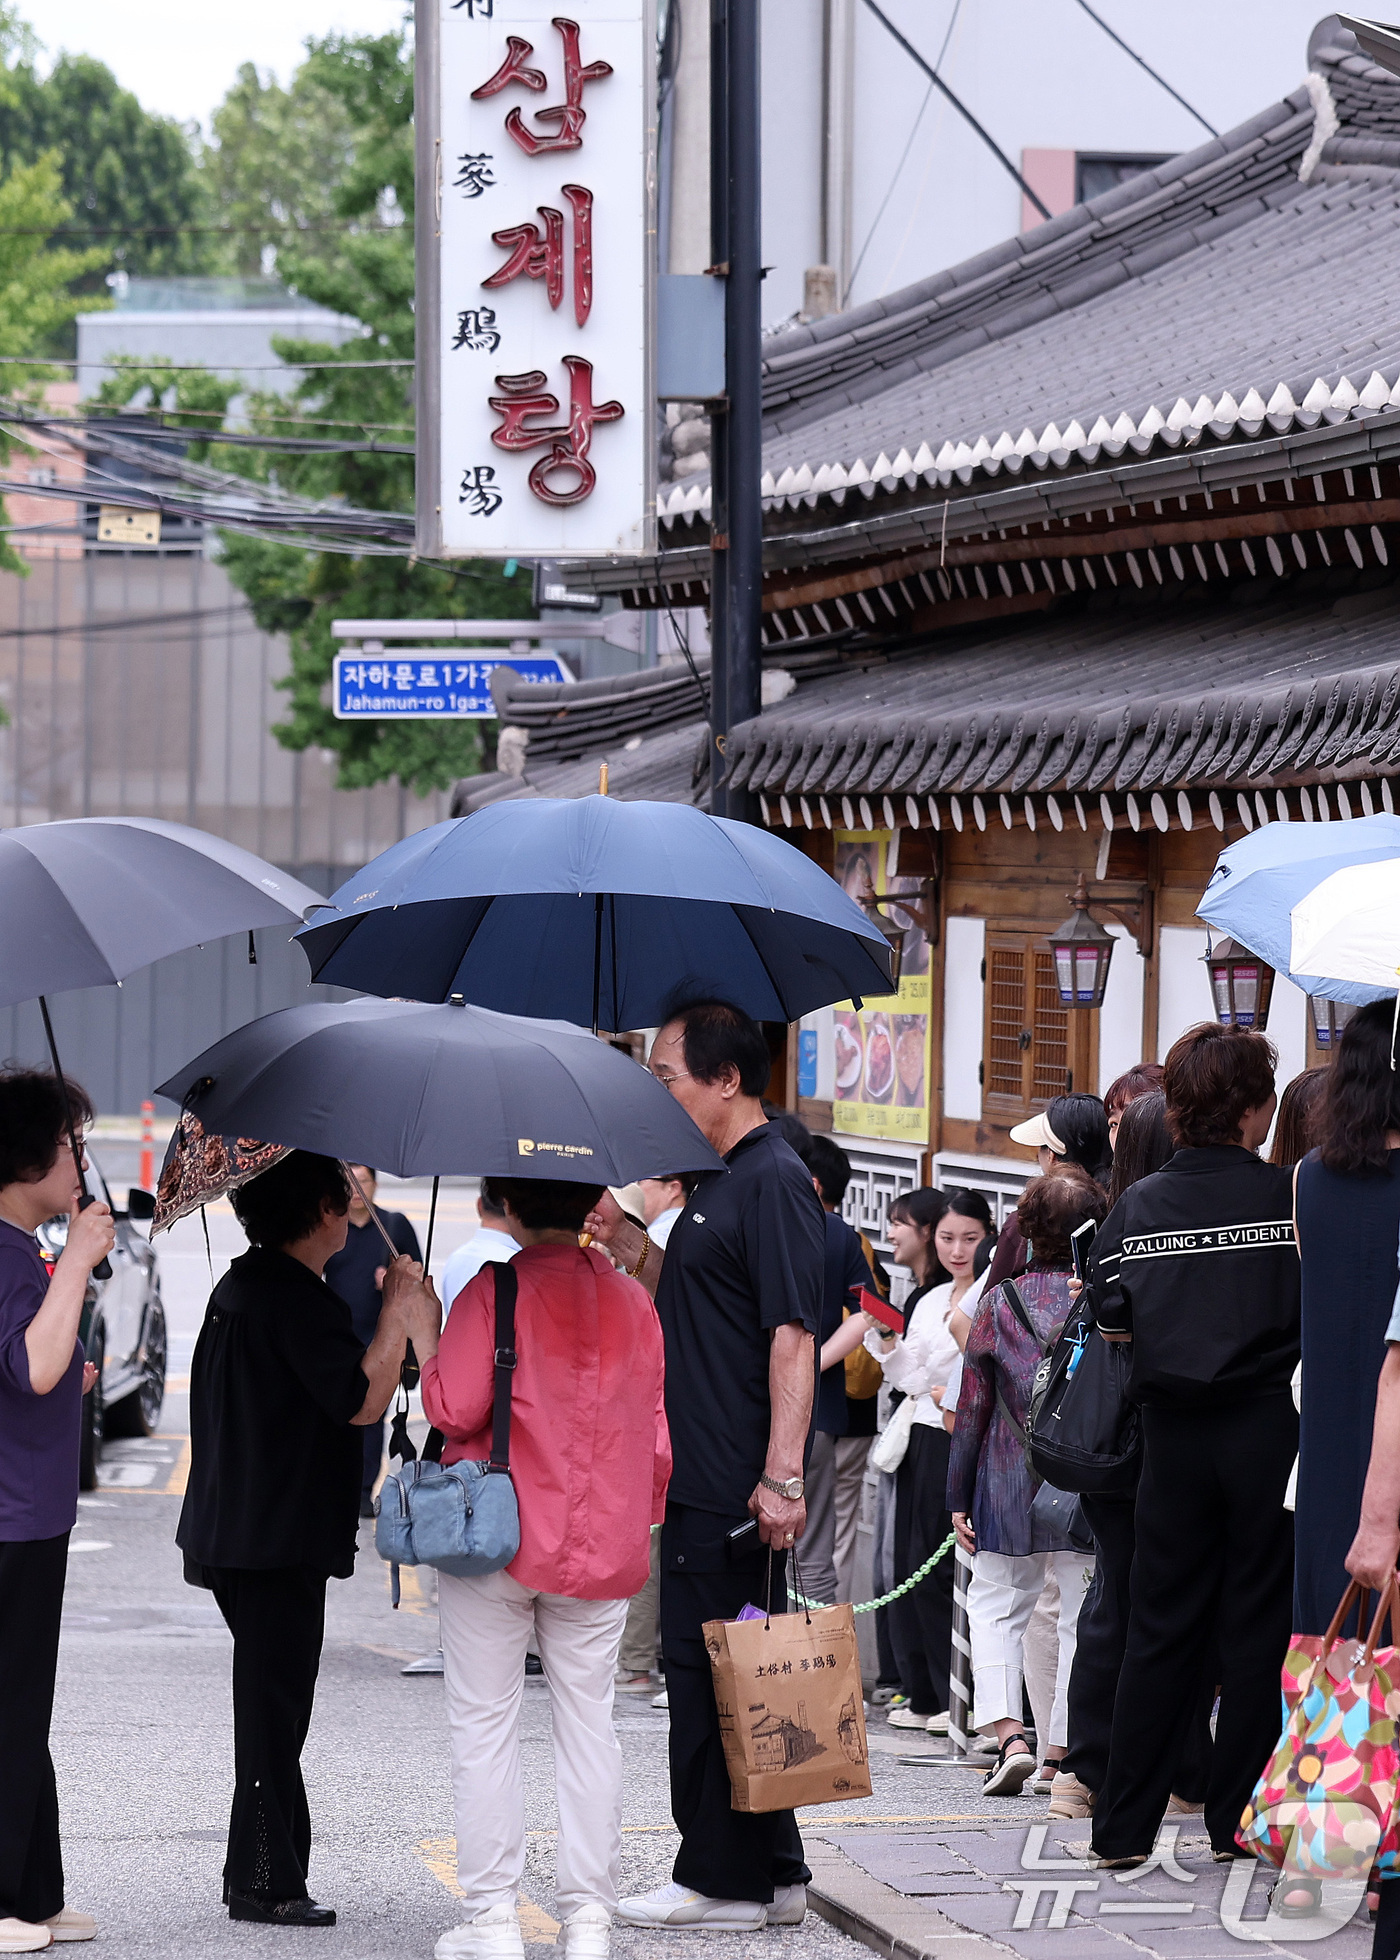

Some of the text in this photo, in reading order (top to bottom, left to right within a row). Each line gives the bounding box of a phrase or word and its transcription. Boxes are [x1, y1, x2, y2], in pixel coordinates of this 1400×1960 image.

[470, 16, 626, 508] 삼계탕
[343, 693, 445, 711] Jahamun-ro
[537, 1142, 594, 1156] pierre cardin
[1122, 1226, 1293, 1255] V.ALUING EVIDENT
